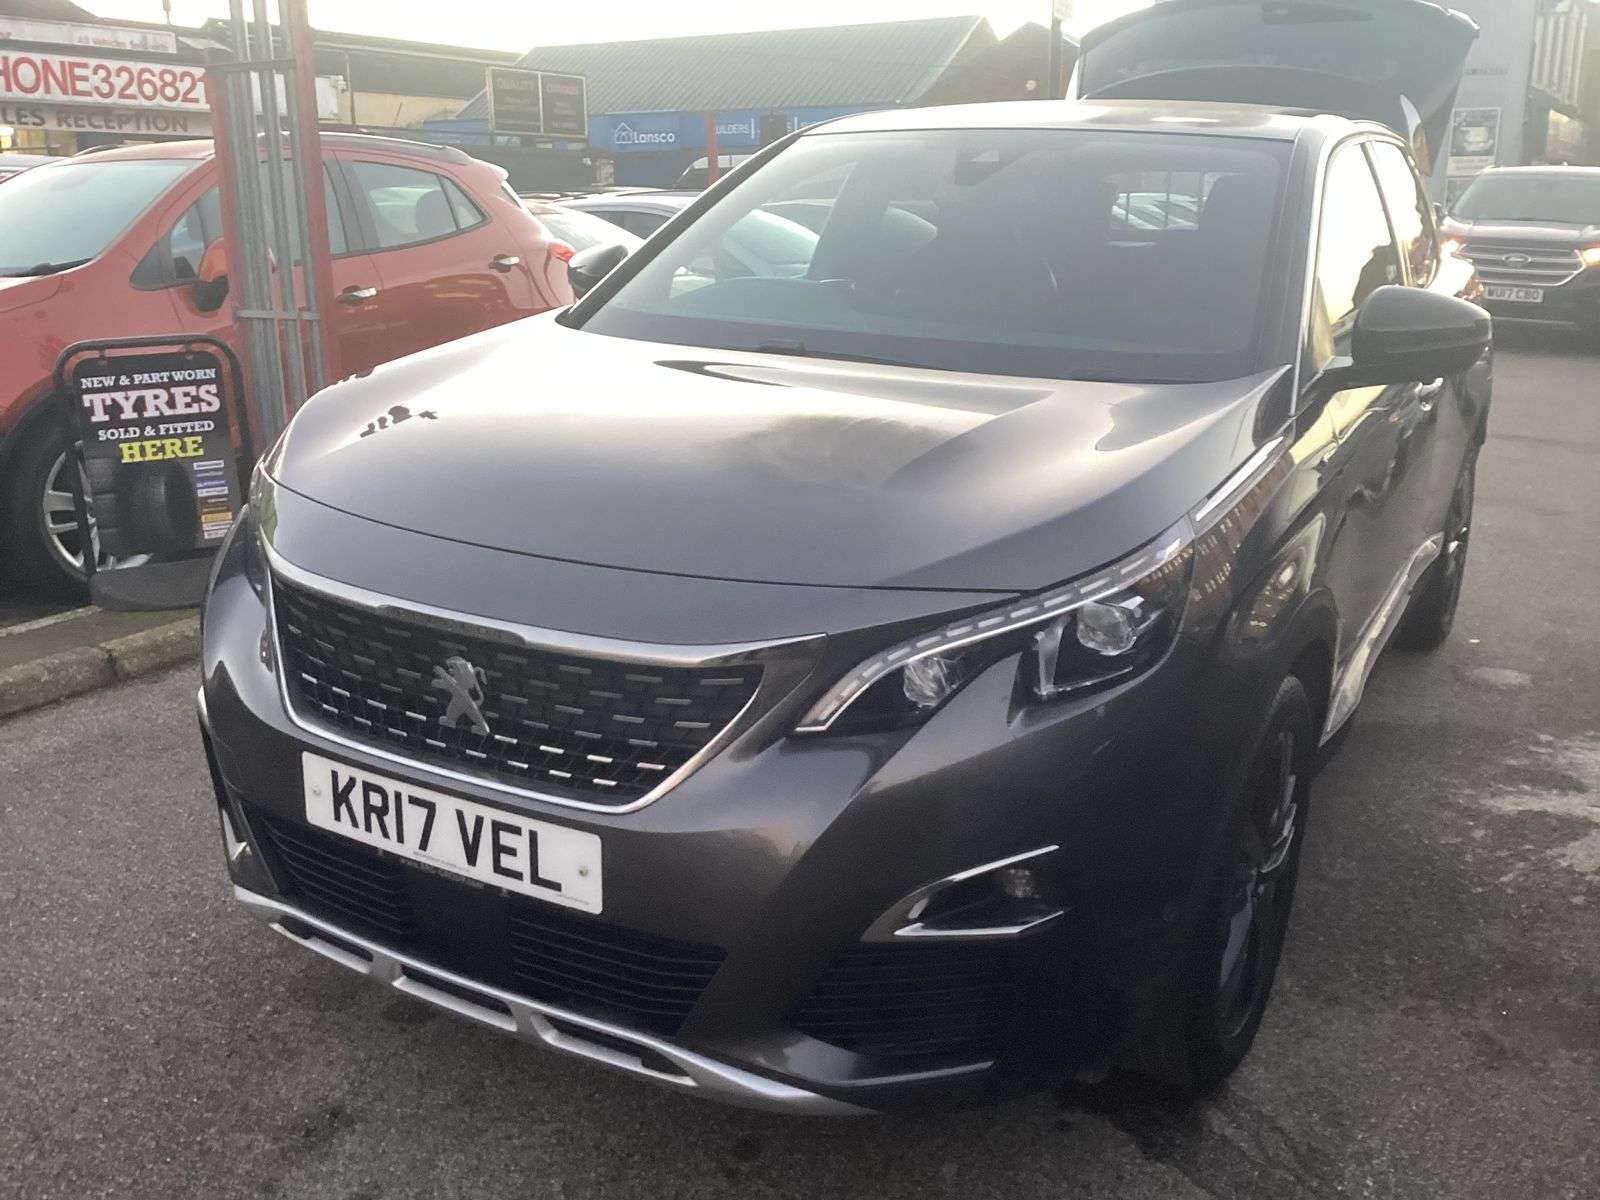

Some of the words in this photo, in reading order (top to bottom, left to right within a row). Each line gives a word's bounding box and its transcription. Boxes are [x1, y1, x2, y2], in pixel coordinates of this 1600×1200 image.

[1, 107, 45, 126] LES
[56, 110, 189, 132] RECEPTION
[633, 131, 675, 144] Lansco
[80, 376, 116, 389] NEW
[119, 375, 131, 386] &
[132, 372, 170, 385] PART
[169, 368, 216, 382] WORN
[82, 384, 221, 422] TYRES
[98, 426, 140, 441] SOLD
[143, 425, 156, 437] &
[158, 420, 215, 435] FITTED
[119, 436, 204, 464] HERE
[330, 769, 437, 852] KR17
[455, 808, 562, 893] VEL
